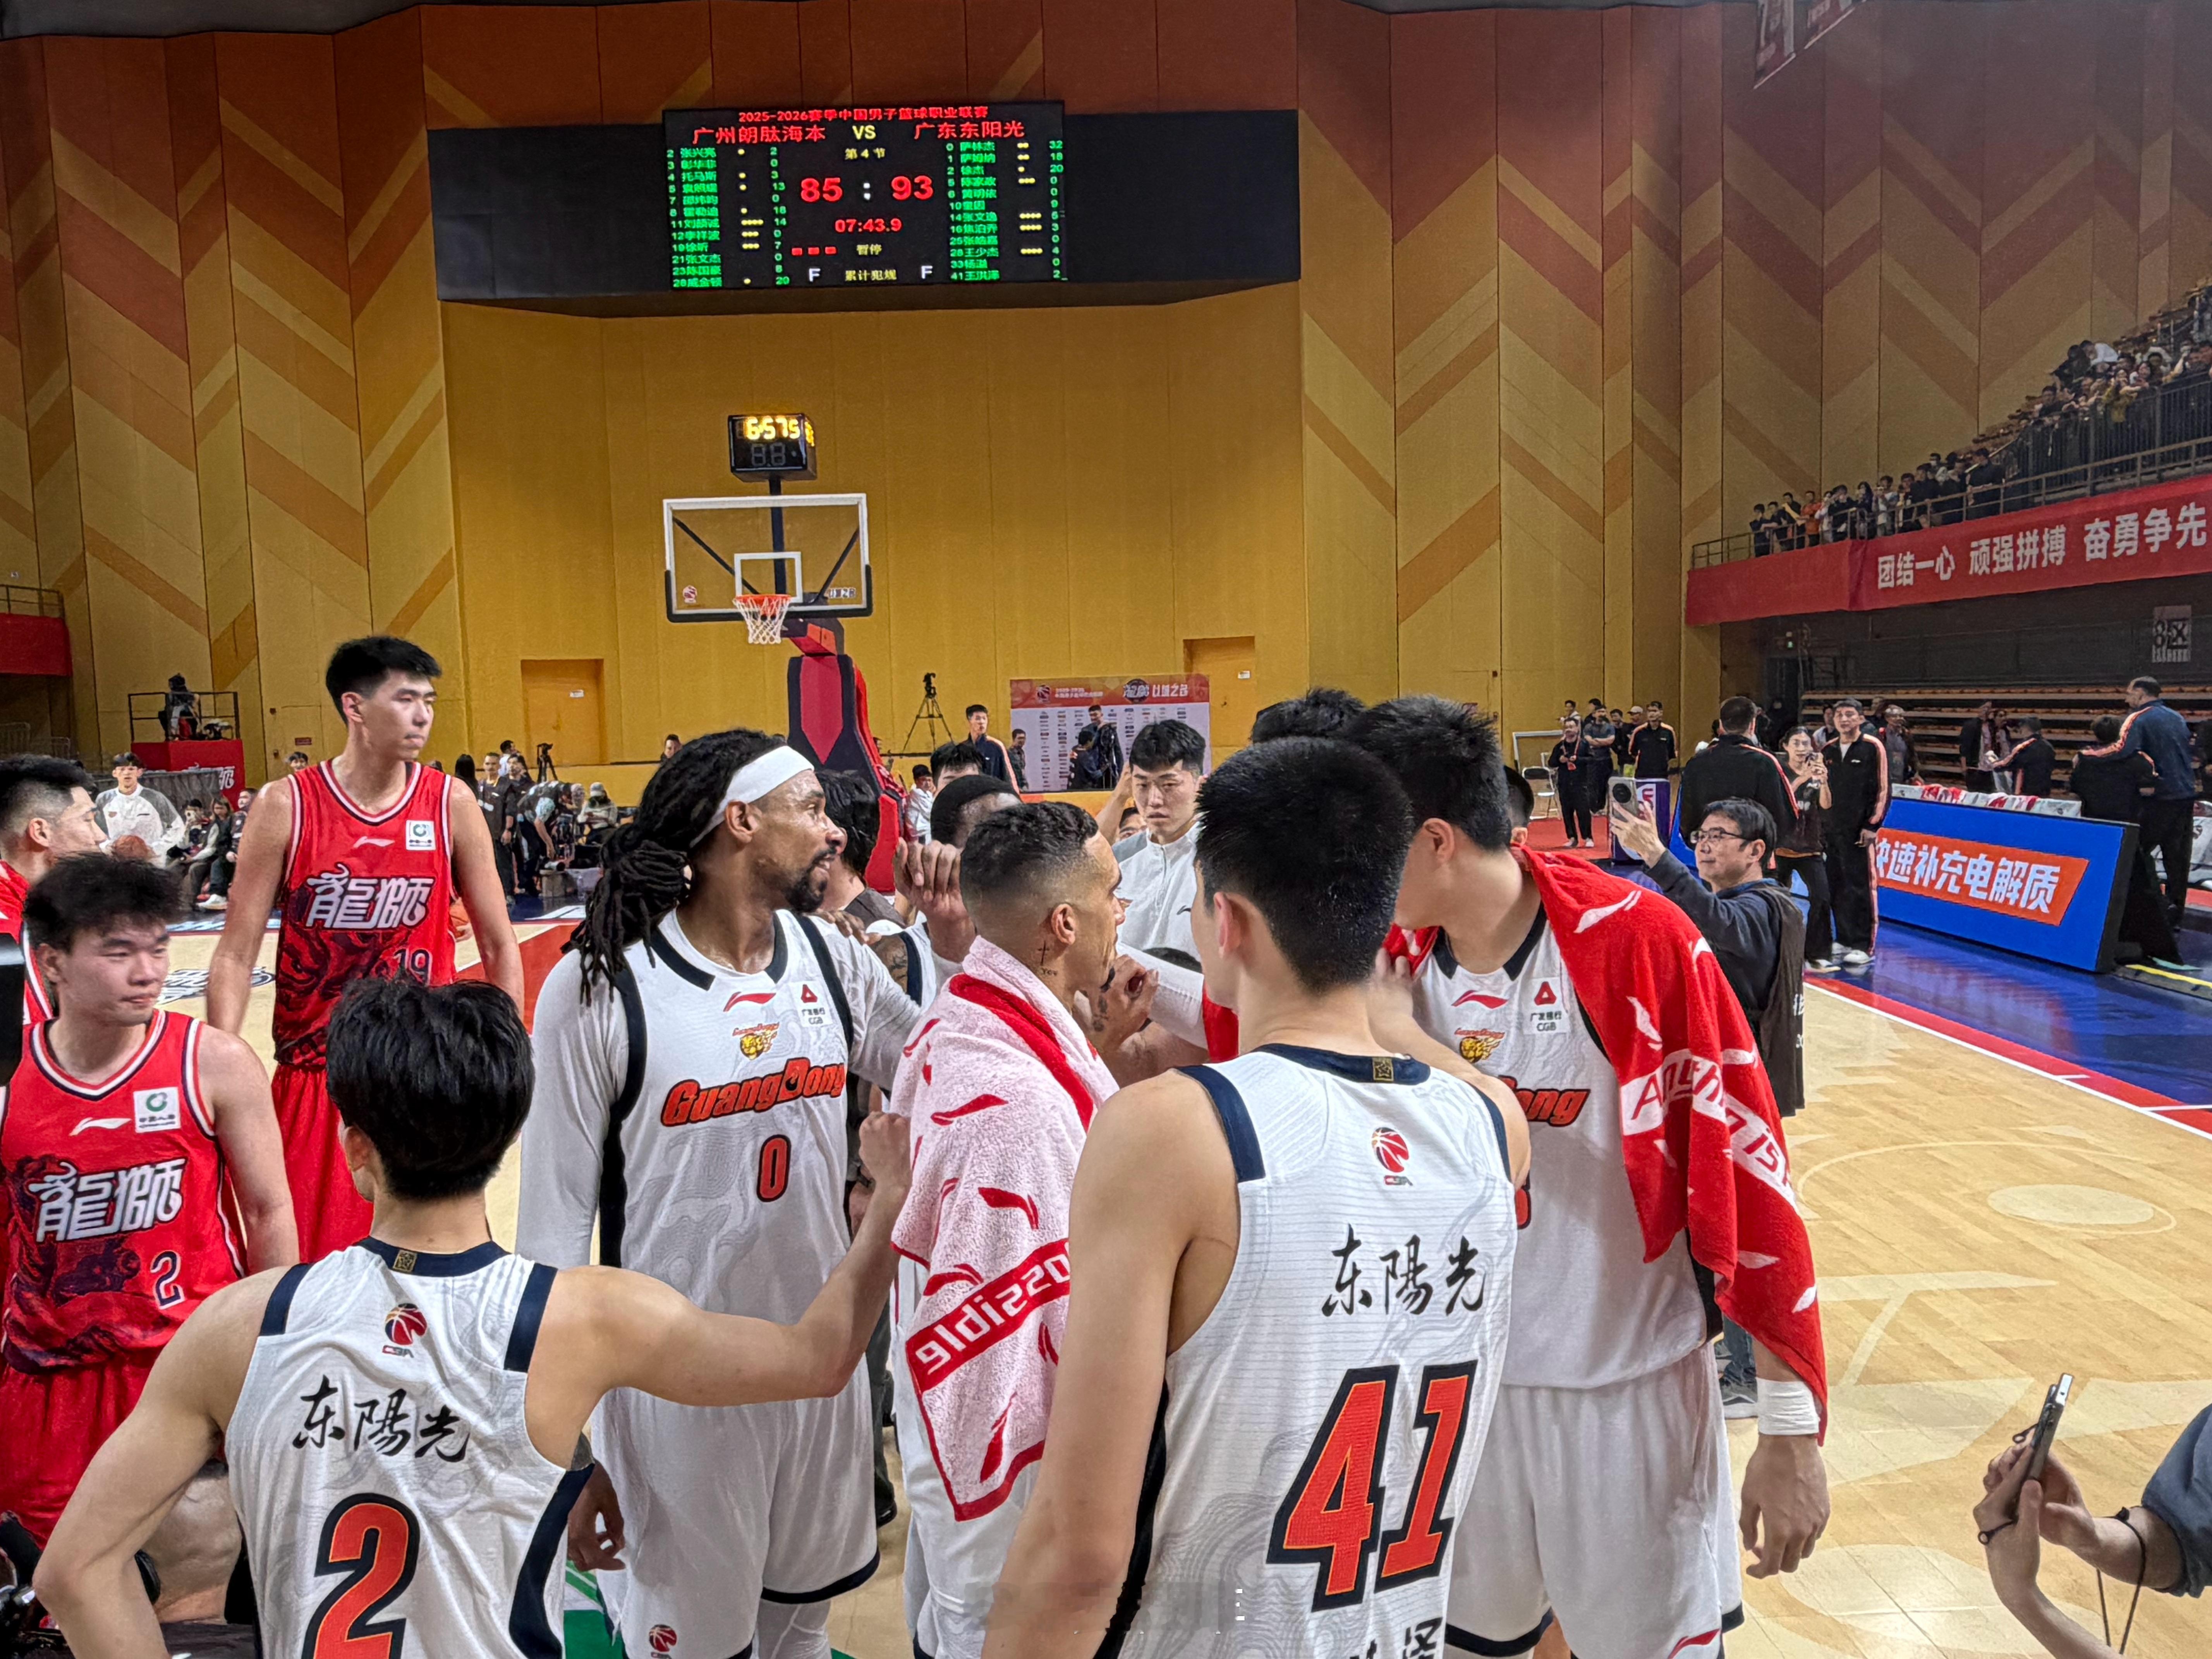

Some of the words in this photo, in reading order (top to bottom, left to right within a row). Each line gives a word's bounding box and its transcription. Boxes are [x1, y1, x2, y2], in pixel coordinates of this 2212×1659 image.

[852, 125, 876, 140] VS
[914, 120, 1025, 139] 广东东阳光
[692, 125, 825, 144] 广州朗肽海本
[946, 143, 954, 151] 0
[771, 159, 778, 167] 0
[947, 167, 954, 175] 2
[1049, 164, 1064, 173] 20
[1050, 176, 1058, 184] 0
[800, 177, 843, 202] 85
[891, 175, 934, 200] 93
[1050, 187, 1058, 196] 0
[669, 197, 676, 205] 7
[772, 194, 780, 203] 0
[949, 201, 961, 210] 10
[835, 218, 902, 232] 07:43.9
[774, 230, 781, 238] 0
[1051, 235, 1060, 243] 0
[775, 241, 781, 249] 7
[775, 253, 782, 261] 0
[1052, 258, 1060, 266] 0
[809, 268, 820, 282] F
[921, 265, 933, 279] F
[950, 272, 963, 280] 41
[1053, 270, 1060, 278] 2
[1877, 545, 1955, 589] 团结一心
[1968, 524, 2067, 576] 顽强拼搏
[2084, 502, 2207, 562] 奋勇争先
[1876, 838, 2060, 914] 快速补充电解质
[756, 1134, 791, 1202] 0
[150, 1250, 185, 1310] 2
[1266, 1359, 1478, 1613] 41
[301, 1492, 420, 1659] 2
